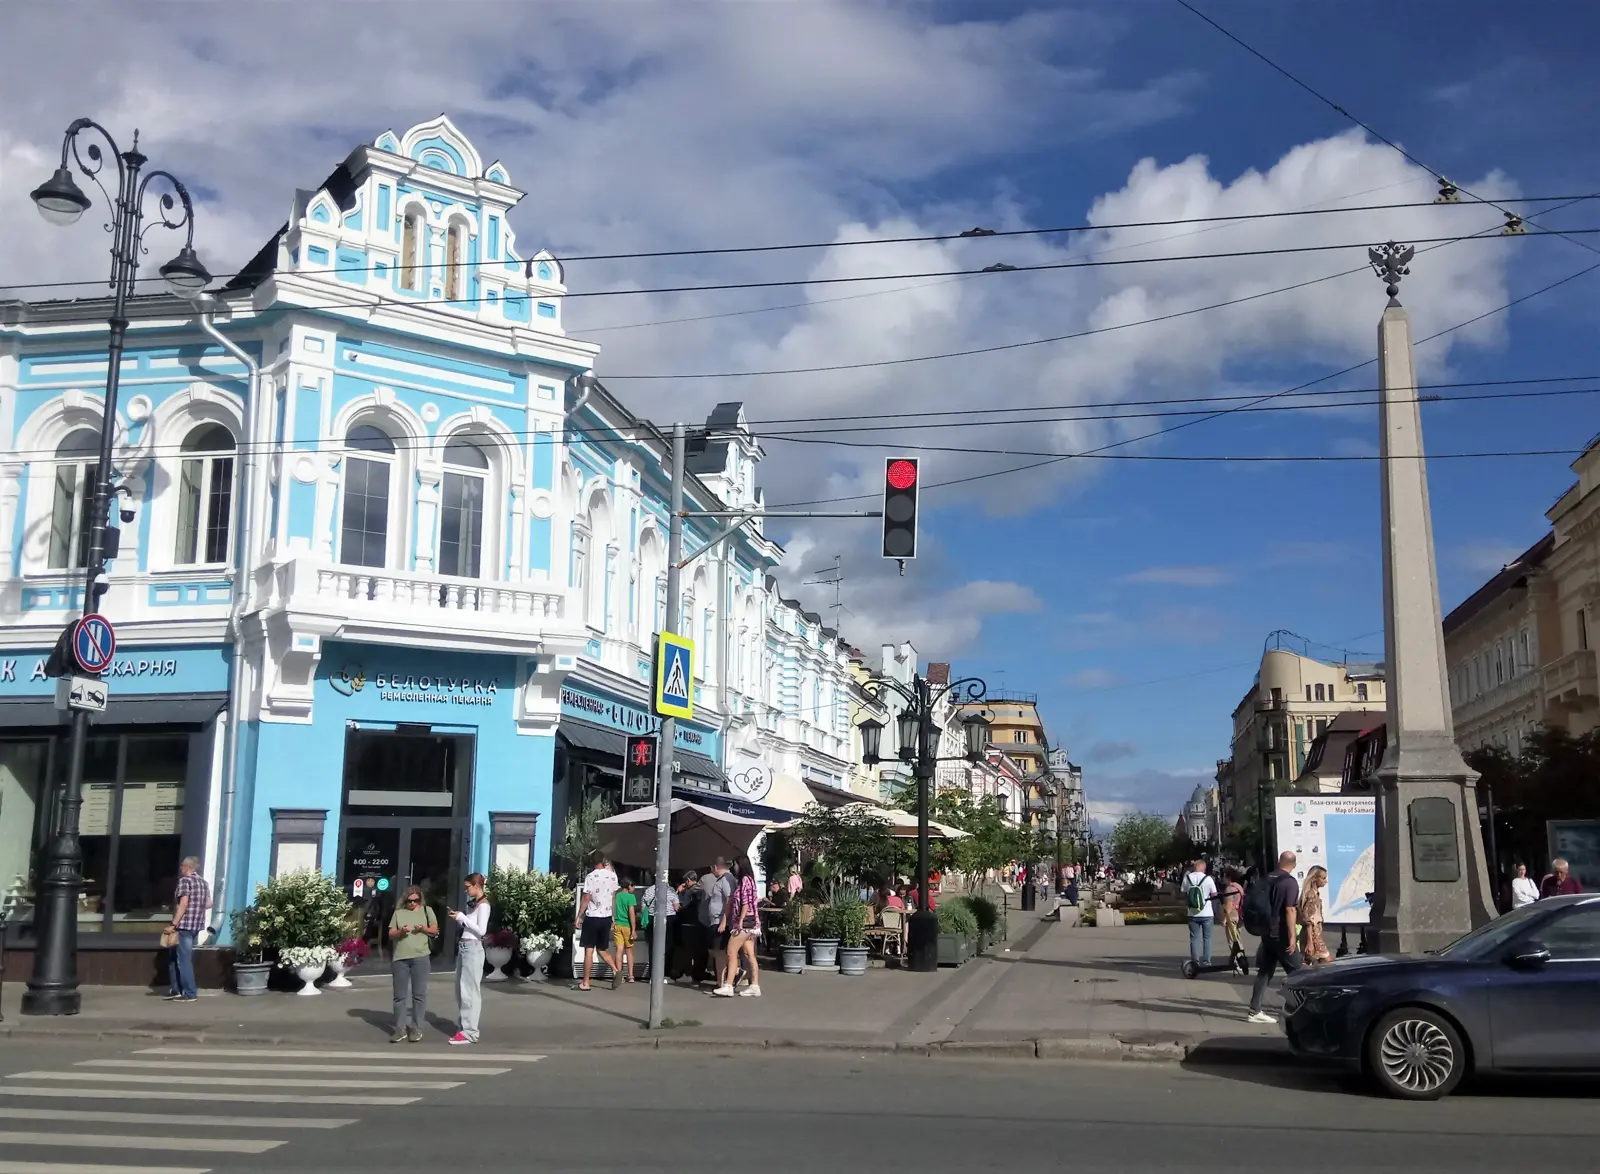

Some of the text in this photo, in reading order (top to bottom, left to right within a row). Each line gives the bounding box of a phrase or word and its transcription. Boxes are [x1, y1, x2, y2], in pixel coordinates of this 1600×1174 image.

[100, 659, 177, 677] ЕКАРНЯ
[376, 674, 497, 694] БЕЛОТУРКА
[381, 691, 493, 706] РЕМЕСЛЕННАЯ ПЕКАРНЯ
